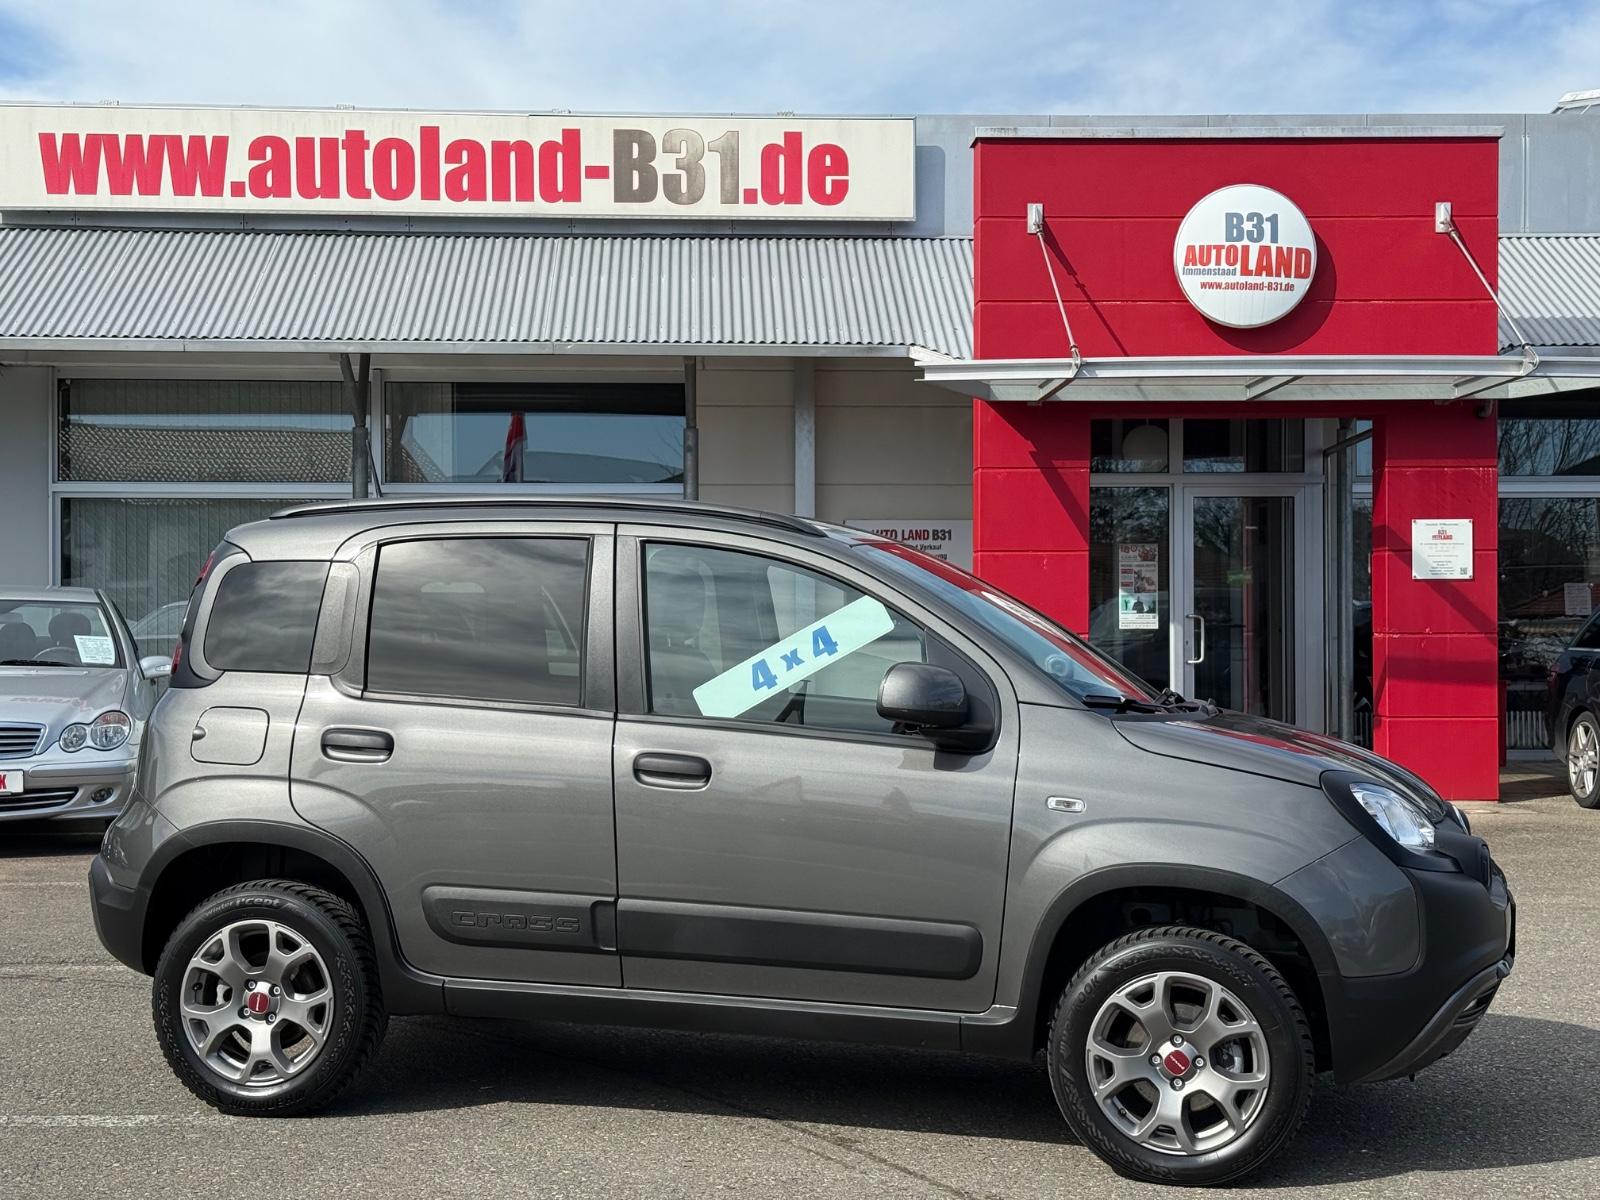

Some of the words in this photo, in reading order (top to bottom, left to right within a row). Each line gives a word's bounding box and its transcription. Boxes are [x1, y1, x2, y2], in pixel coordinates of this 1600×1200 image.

[38, 125, 850, 207] www.autoland-B31.de
[1225, 212, 1279, 244] B31
[1182, 266, 1237, 276] Immenstaad
[1200, 280, 1295, 292] www.autoland-B31.de
[901, 529, 930, 541] LAND
[932, 529, 952, 541] B31
[919, 543, 942, 551] Verkauf
[751, 658, 778, 692] 4
[812, 625, 839, 658] 4
